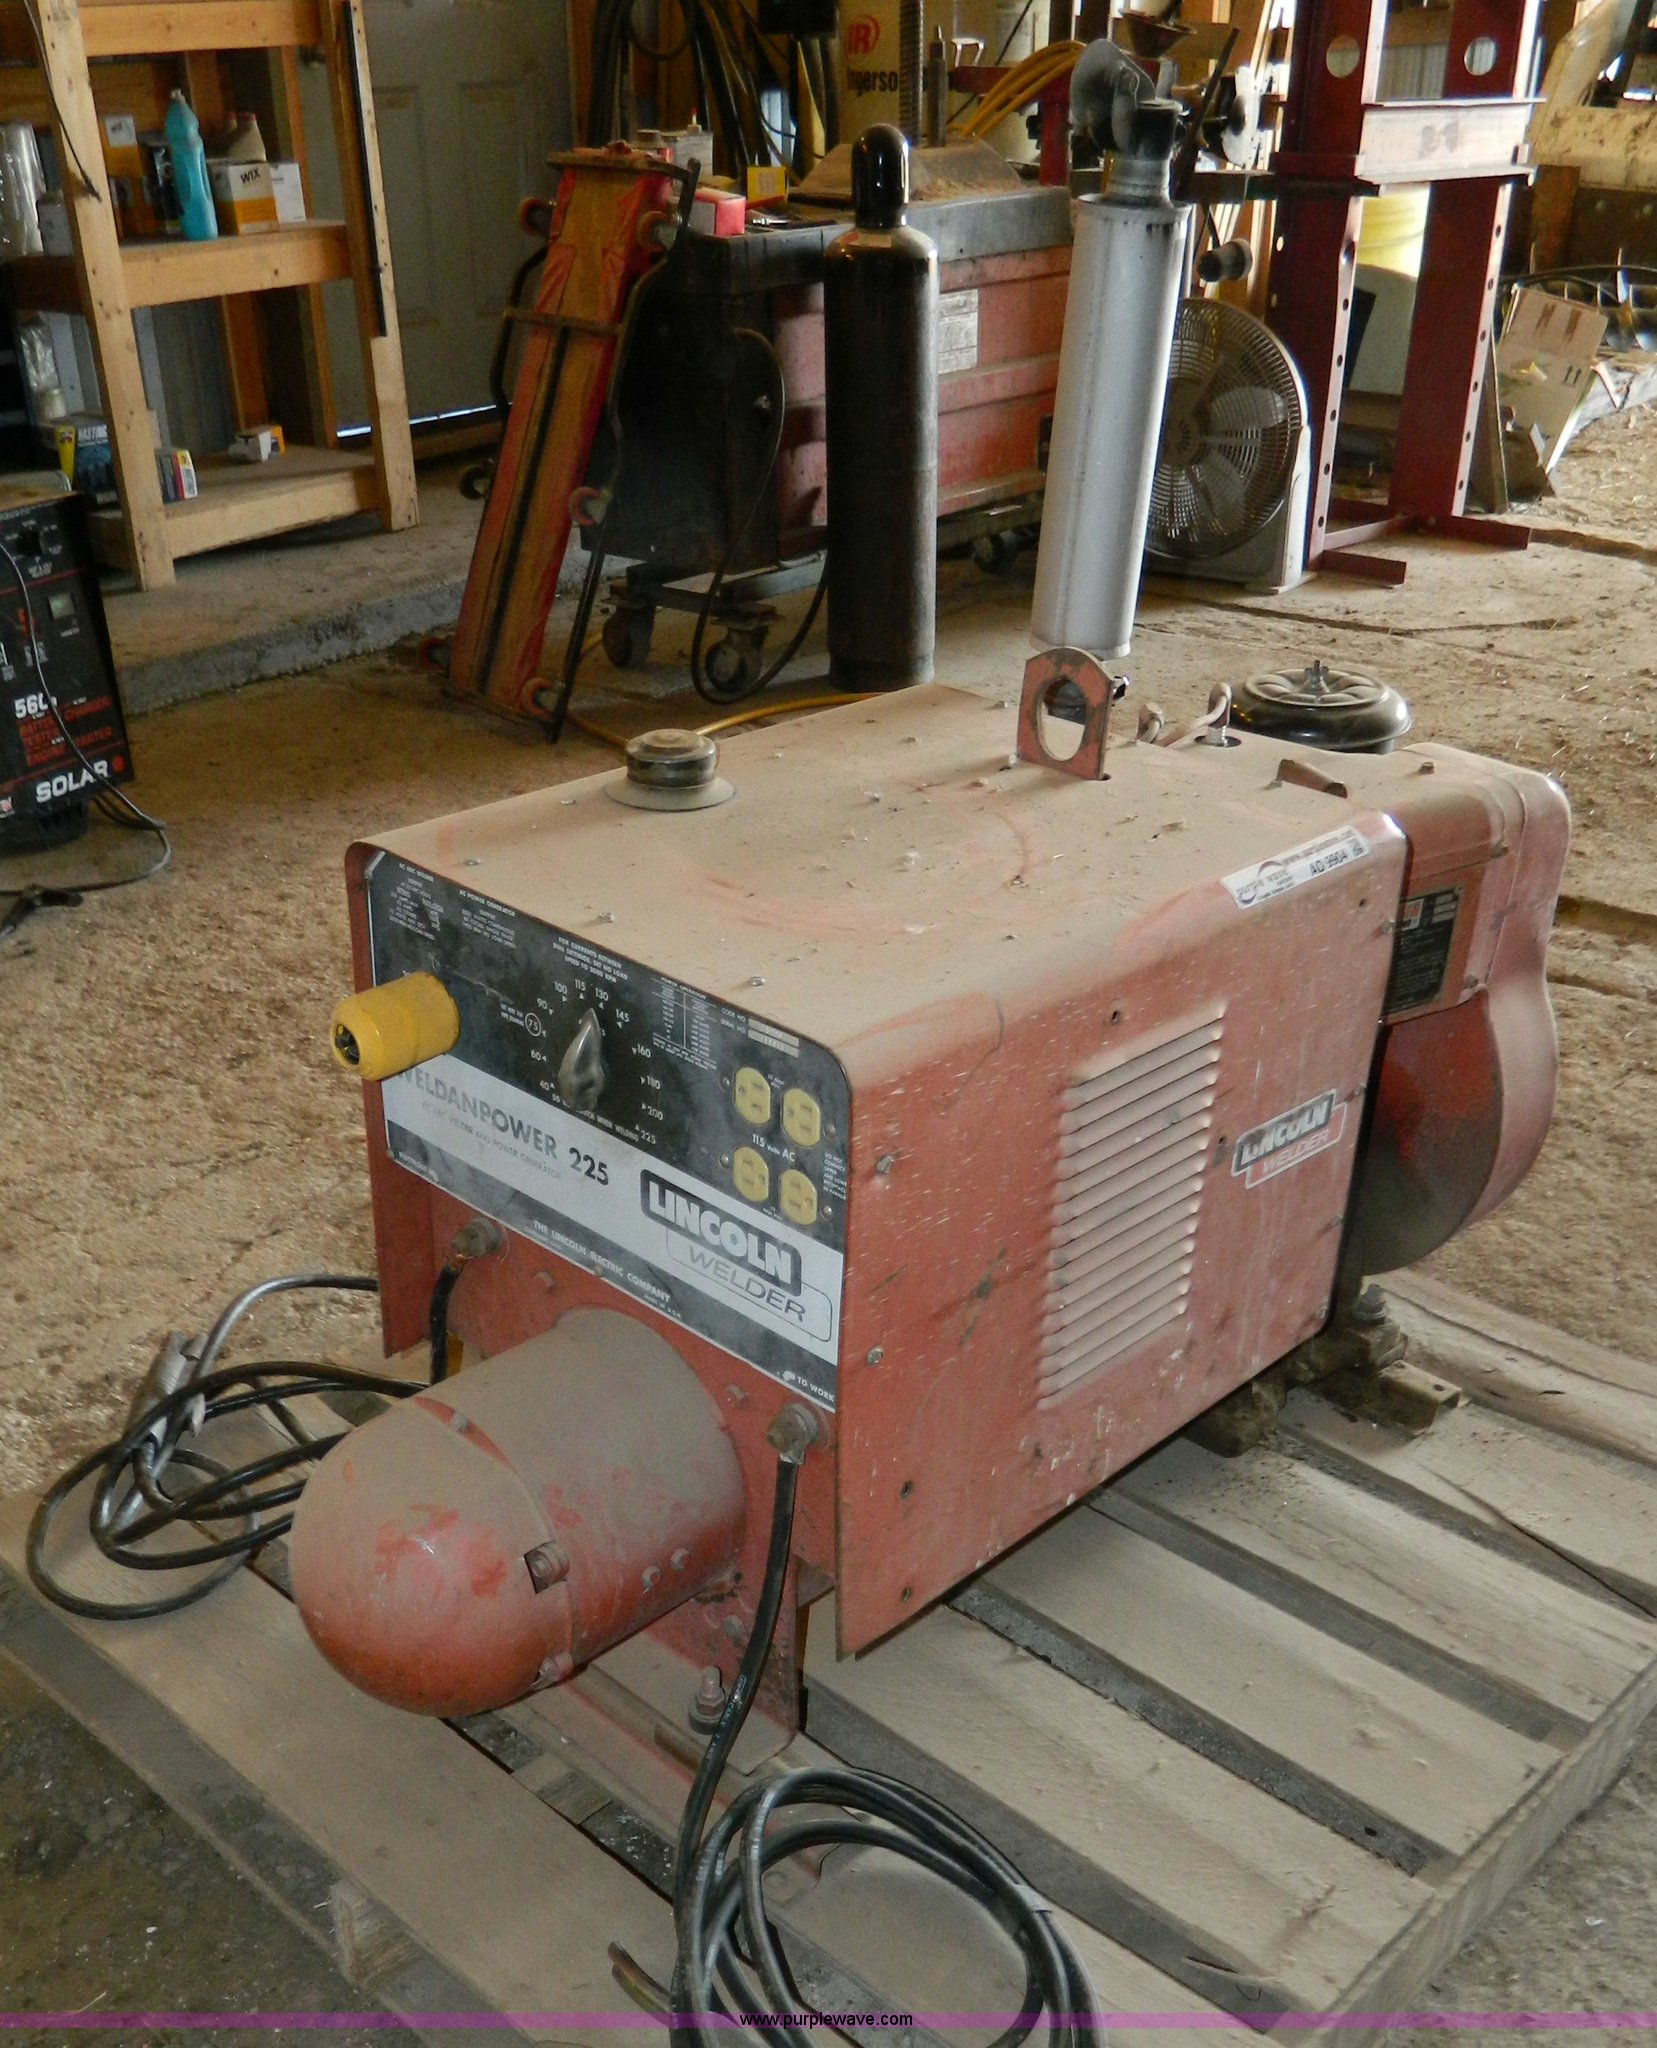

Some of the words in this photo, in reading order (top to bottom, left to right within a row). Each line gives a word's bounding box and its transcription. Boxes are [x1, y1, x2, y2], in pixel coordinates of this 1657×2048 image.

[847, 66, 899, 97] Ingerso
[240, 167, 261, 184] WIX
[36, 760, 109, 803] SOLAR
[554, 981, 568, 995] 100
[574, 979, 586, 992] 115
[595, 987, 609, 1001] 130
[537, 998, 548, 1010] 90
[615, 1008, 630, 1023] 145
[528, 1018, 539, 1031] 75
[530, 1050, 541, 1061] 60
[637, 1043, 651, 1058] 160
[539, 1080, 550, 1091] 40
[646, 1075, 661, 1090] 180
[648, 1107, 664, 1121] 200
[640, 1129, 656, 1145] 225
[1241, 1099, 1329, 1166] LINCOLN
[752, 1133, 765, 1148] 115
[782, 1148, 796, 1162] AC
[1263, 1128, 1329, 1172] WELDER
[568, 1147, 609, 1186] 225
[649, 1180, 791, 1284] LINCOLN
[534, 1220, 548, 1234] THE
[551, 1230, 587, 1255] LINCOLN
[590, 1250, 624, 1277] ELECTRIC
[626, 1272, 671, 1302] COMPANY
[689, 1245, 807, 1323] WELDER
[796, 1375, 808, 1388] TO
[809, 1382, 835, 1402] WORK
